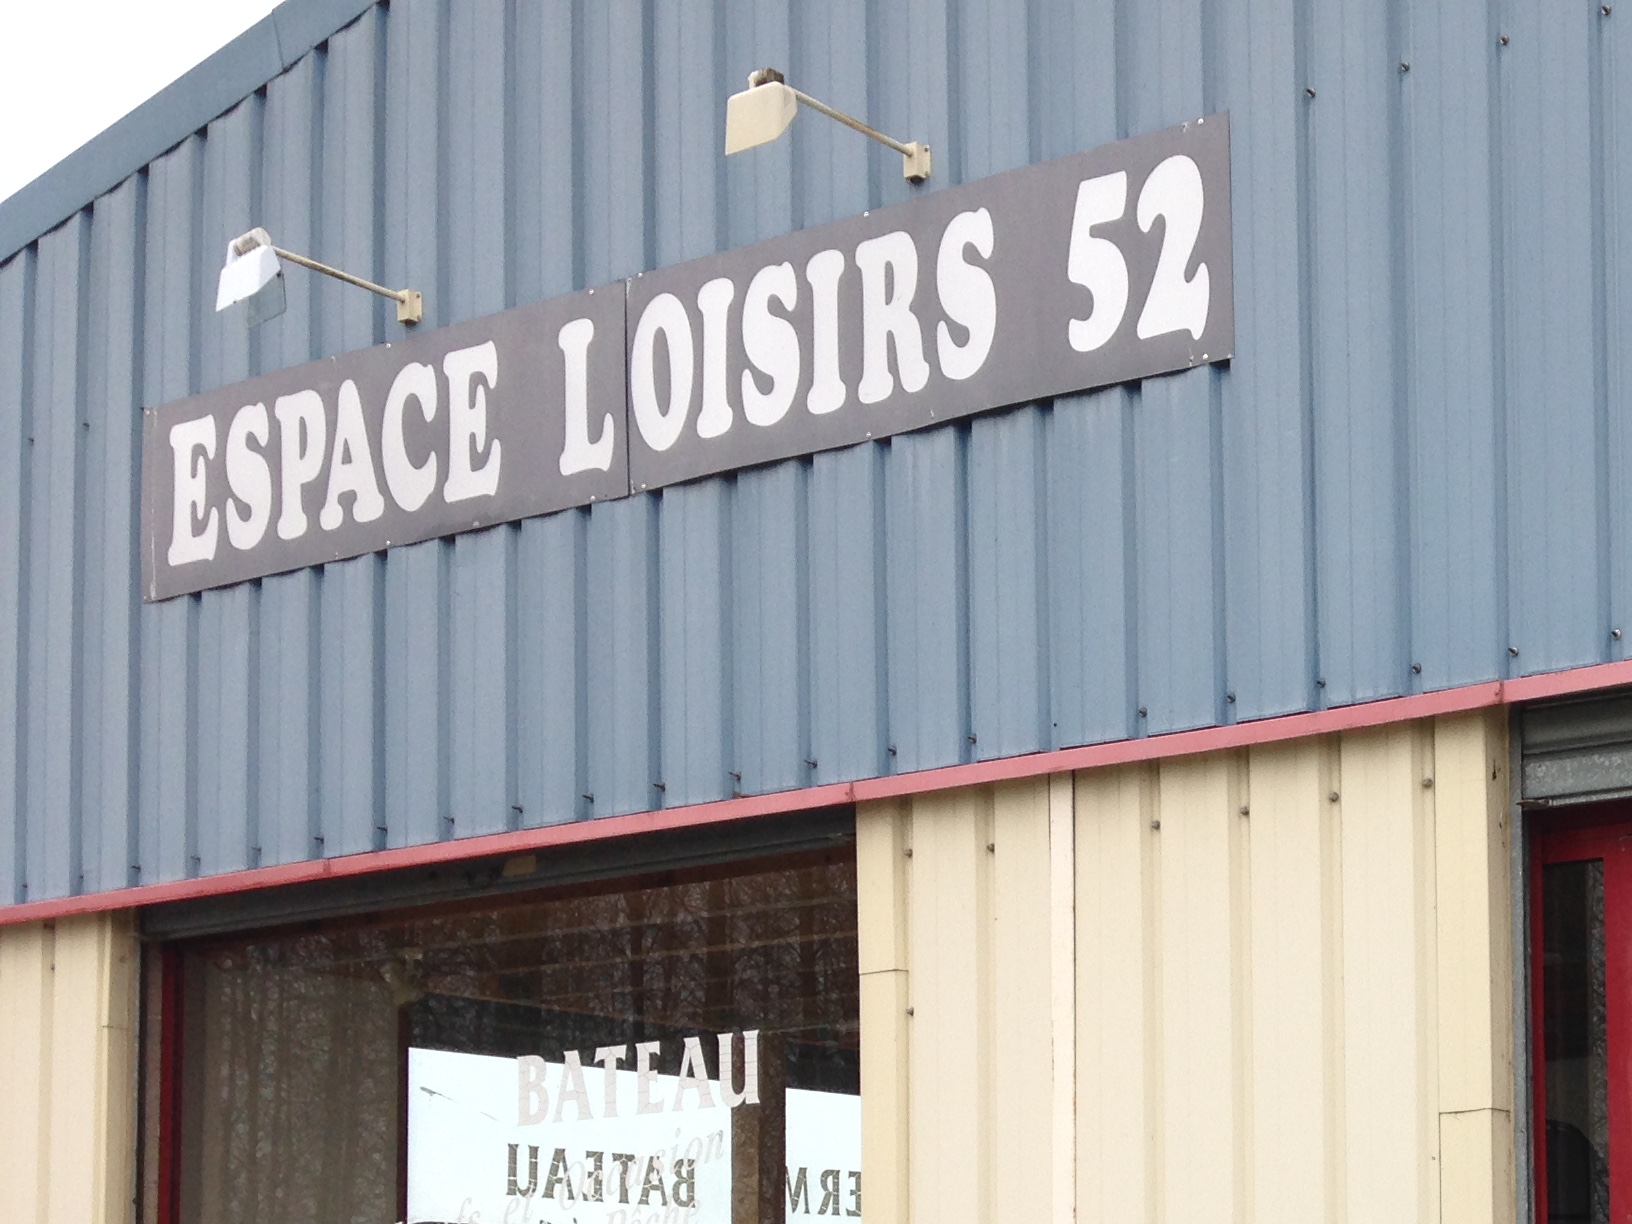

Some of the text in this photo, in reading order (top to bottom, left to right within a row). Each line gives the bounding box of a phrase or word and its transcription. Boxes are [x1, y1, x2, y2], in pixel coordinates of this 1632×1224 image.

[168, 155, 1211, 565] ESPACE LOISIRS 52
[517, 1029, 760, 1126] BATEAU
